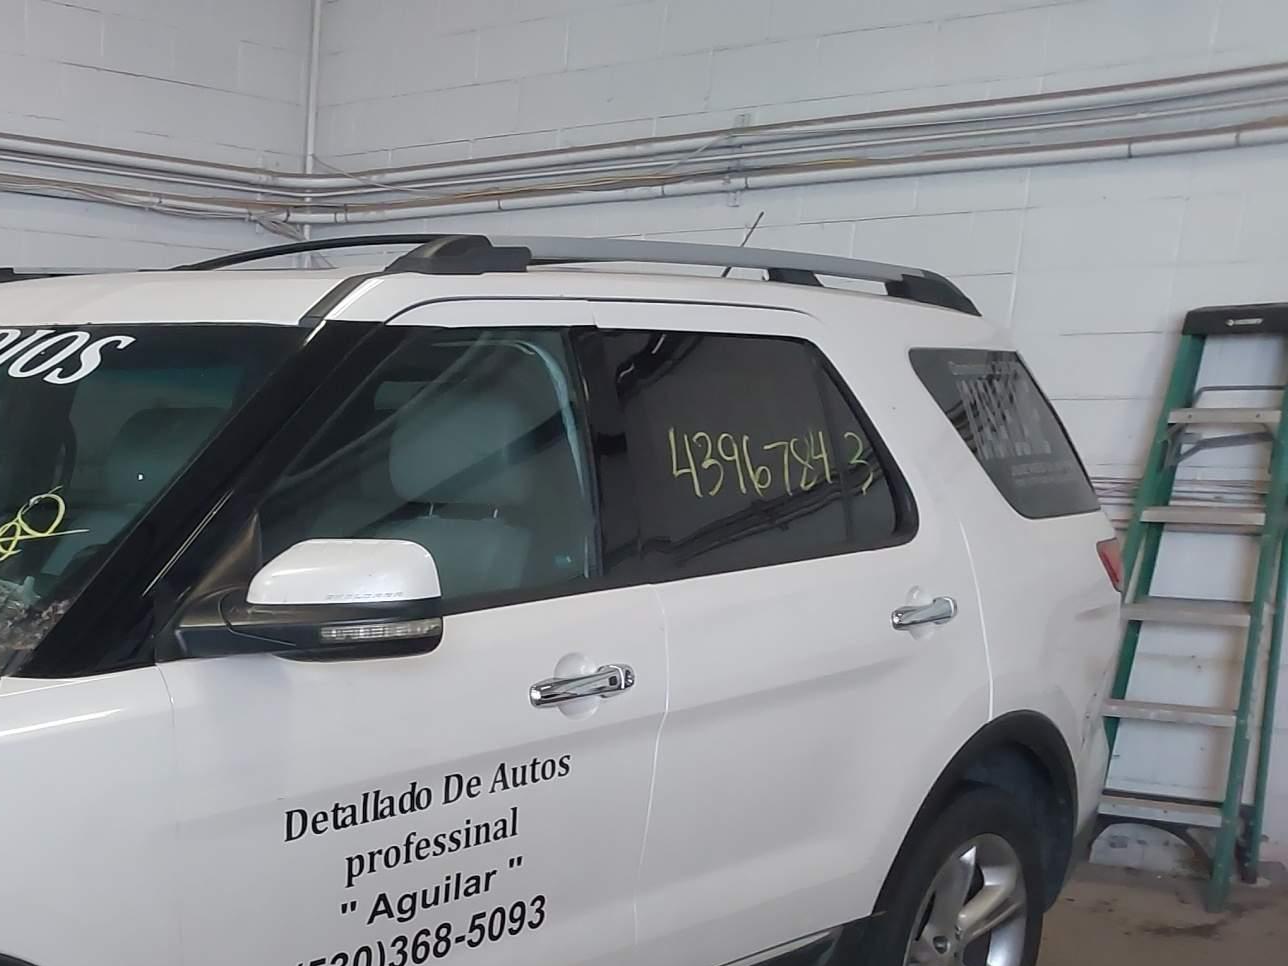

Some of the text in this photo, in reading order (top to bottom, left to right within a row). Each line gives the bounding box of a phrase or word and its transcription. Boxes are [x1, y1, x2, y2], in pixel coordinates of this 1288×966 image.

[668, 426, 874, 497] 43967843
[283, 754, 572, 842] Detallado De Autos
[344, 806, 519, 888] professinal
[367, 869, 498, 925] Aguilar
